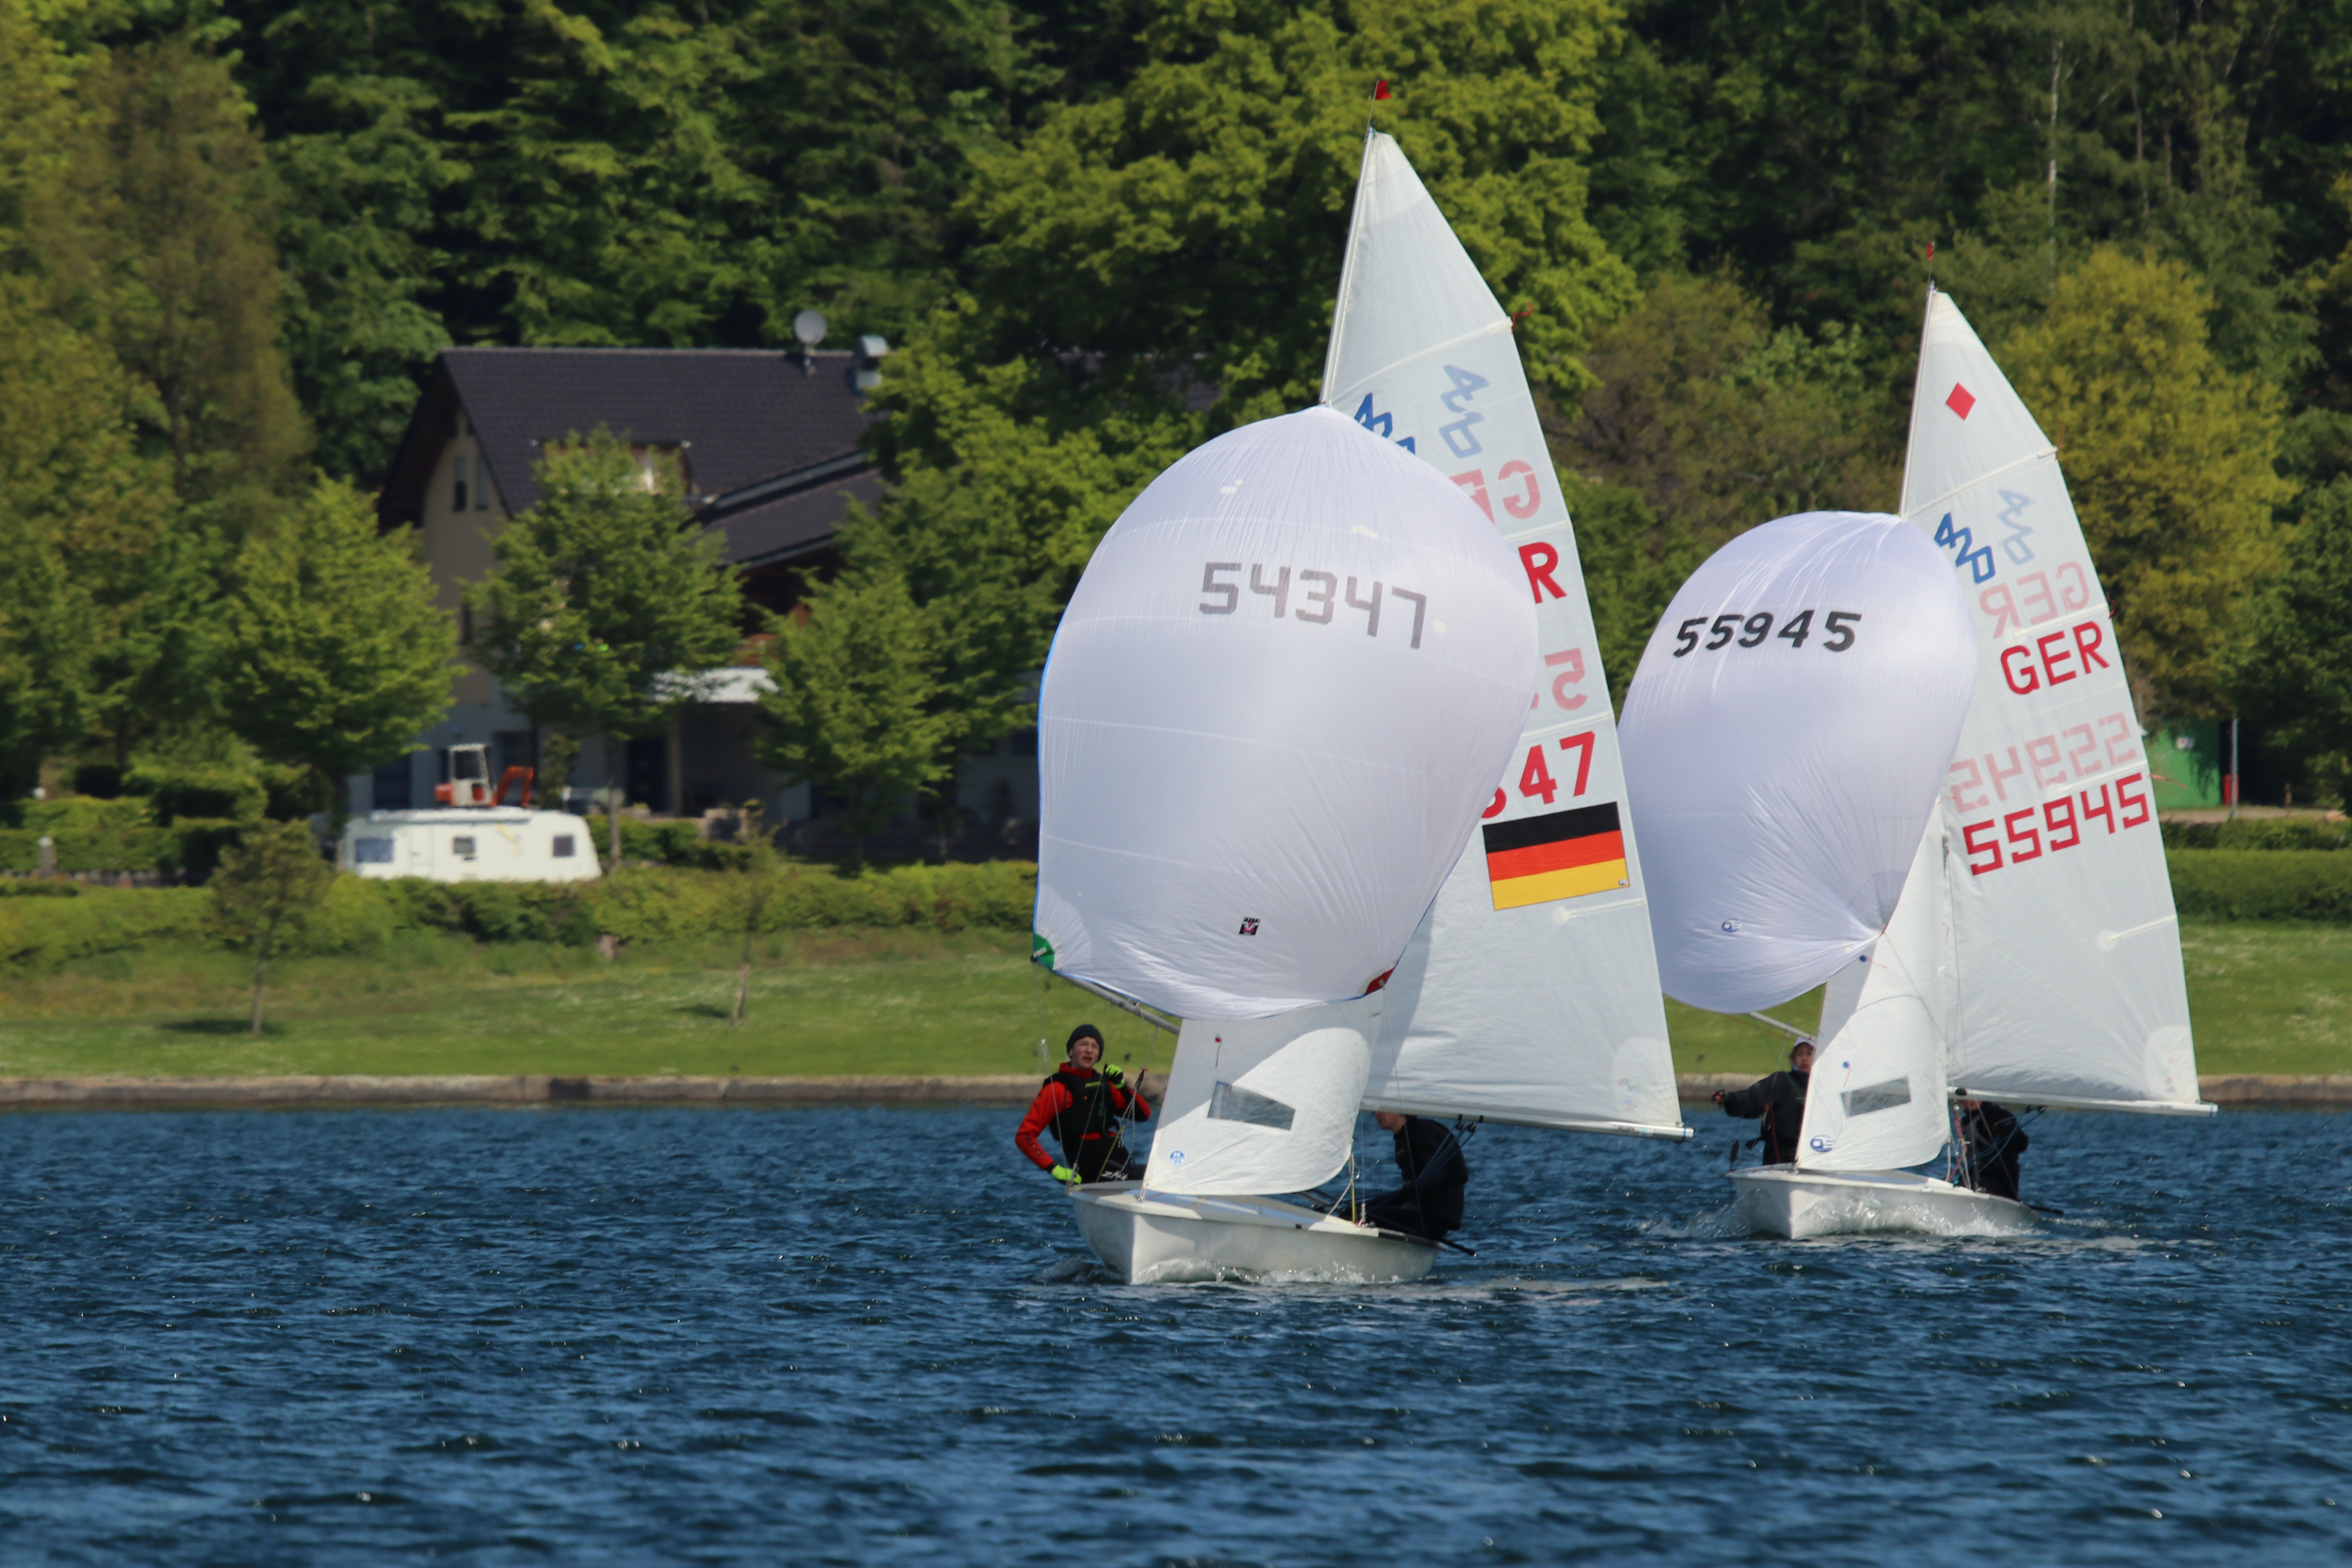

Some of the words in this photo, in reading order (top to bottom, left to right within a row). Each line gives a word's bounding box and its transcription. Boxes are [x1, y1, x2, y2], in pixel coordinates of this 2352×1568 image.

[1934, 512, 1996, 584] 420
[1199, 561, 1427, 650] 54347
[1673, 609, 1863, 658] 55945
[2000, 621, 2111, 695] GER
[1962, 772, 2150, 876] 55945
